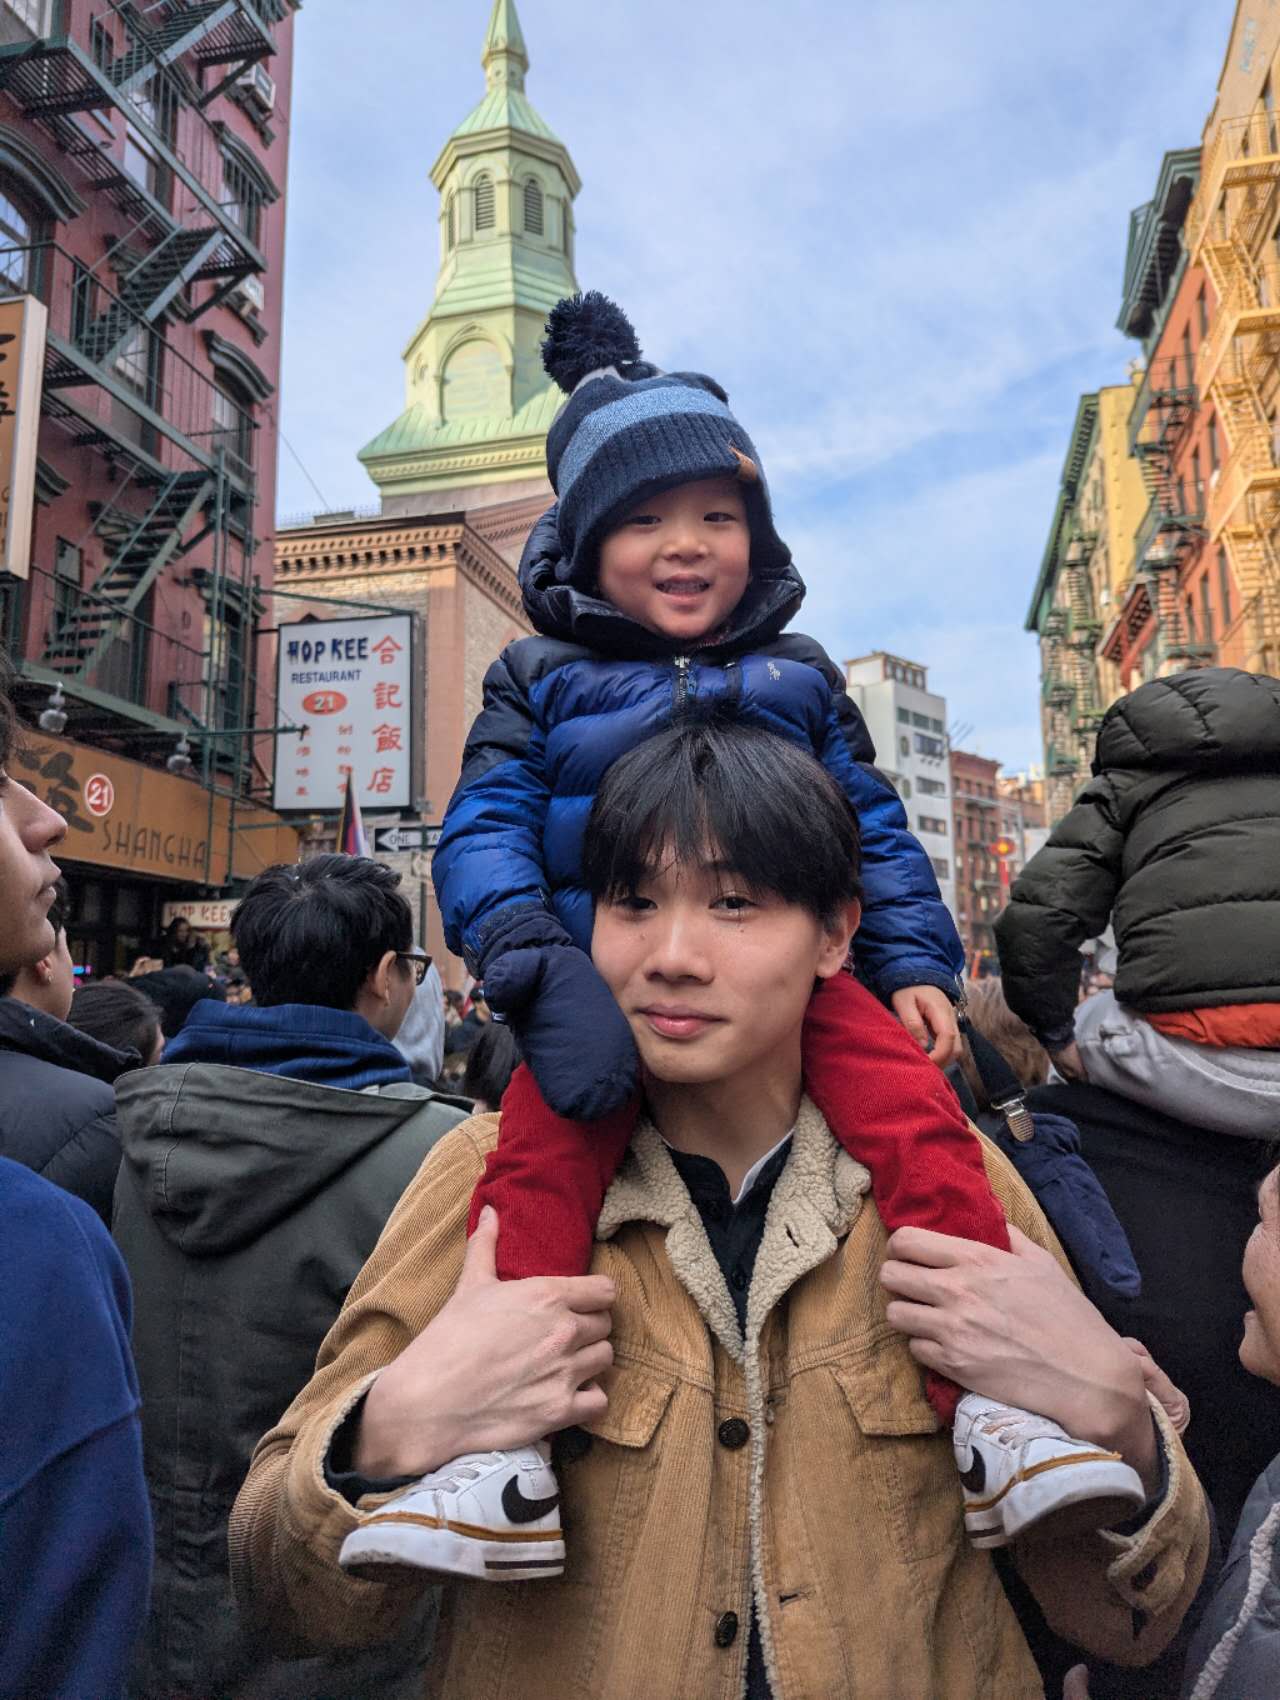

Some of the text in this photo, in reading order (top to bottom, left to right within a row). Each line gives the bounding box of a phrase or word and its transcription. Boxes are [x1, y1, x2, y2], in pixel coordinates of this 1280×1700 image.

[287, 637, 369, 665] HOP KEE
[291, 669, 362, 685] RESTAURANT
[314, 696, 336, 712] 21
[366, 635, 403, 793] 合記飯店
[88, 782, 110, 807] 21
[102, 819, 211, 869] SHANGHA
[389, 833, 411, 846] ONE
